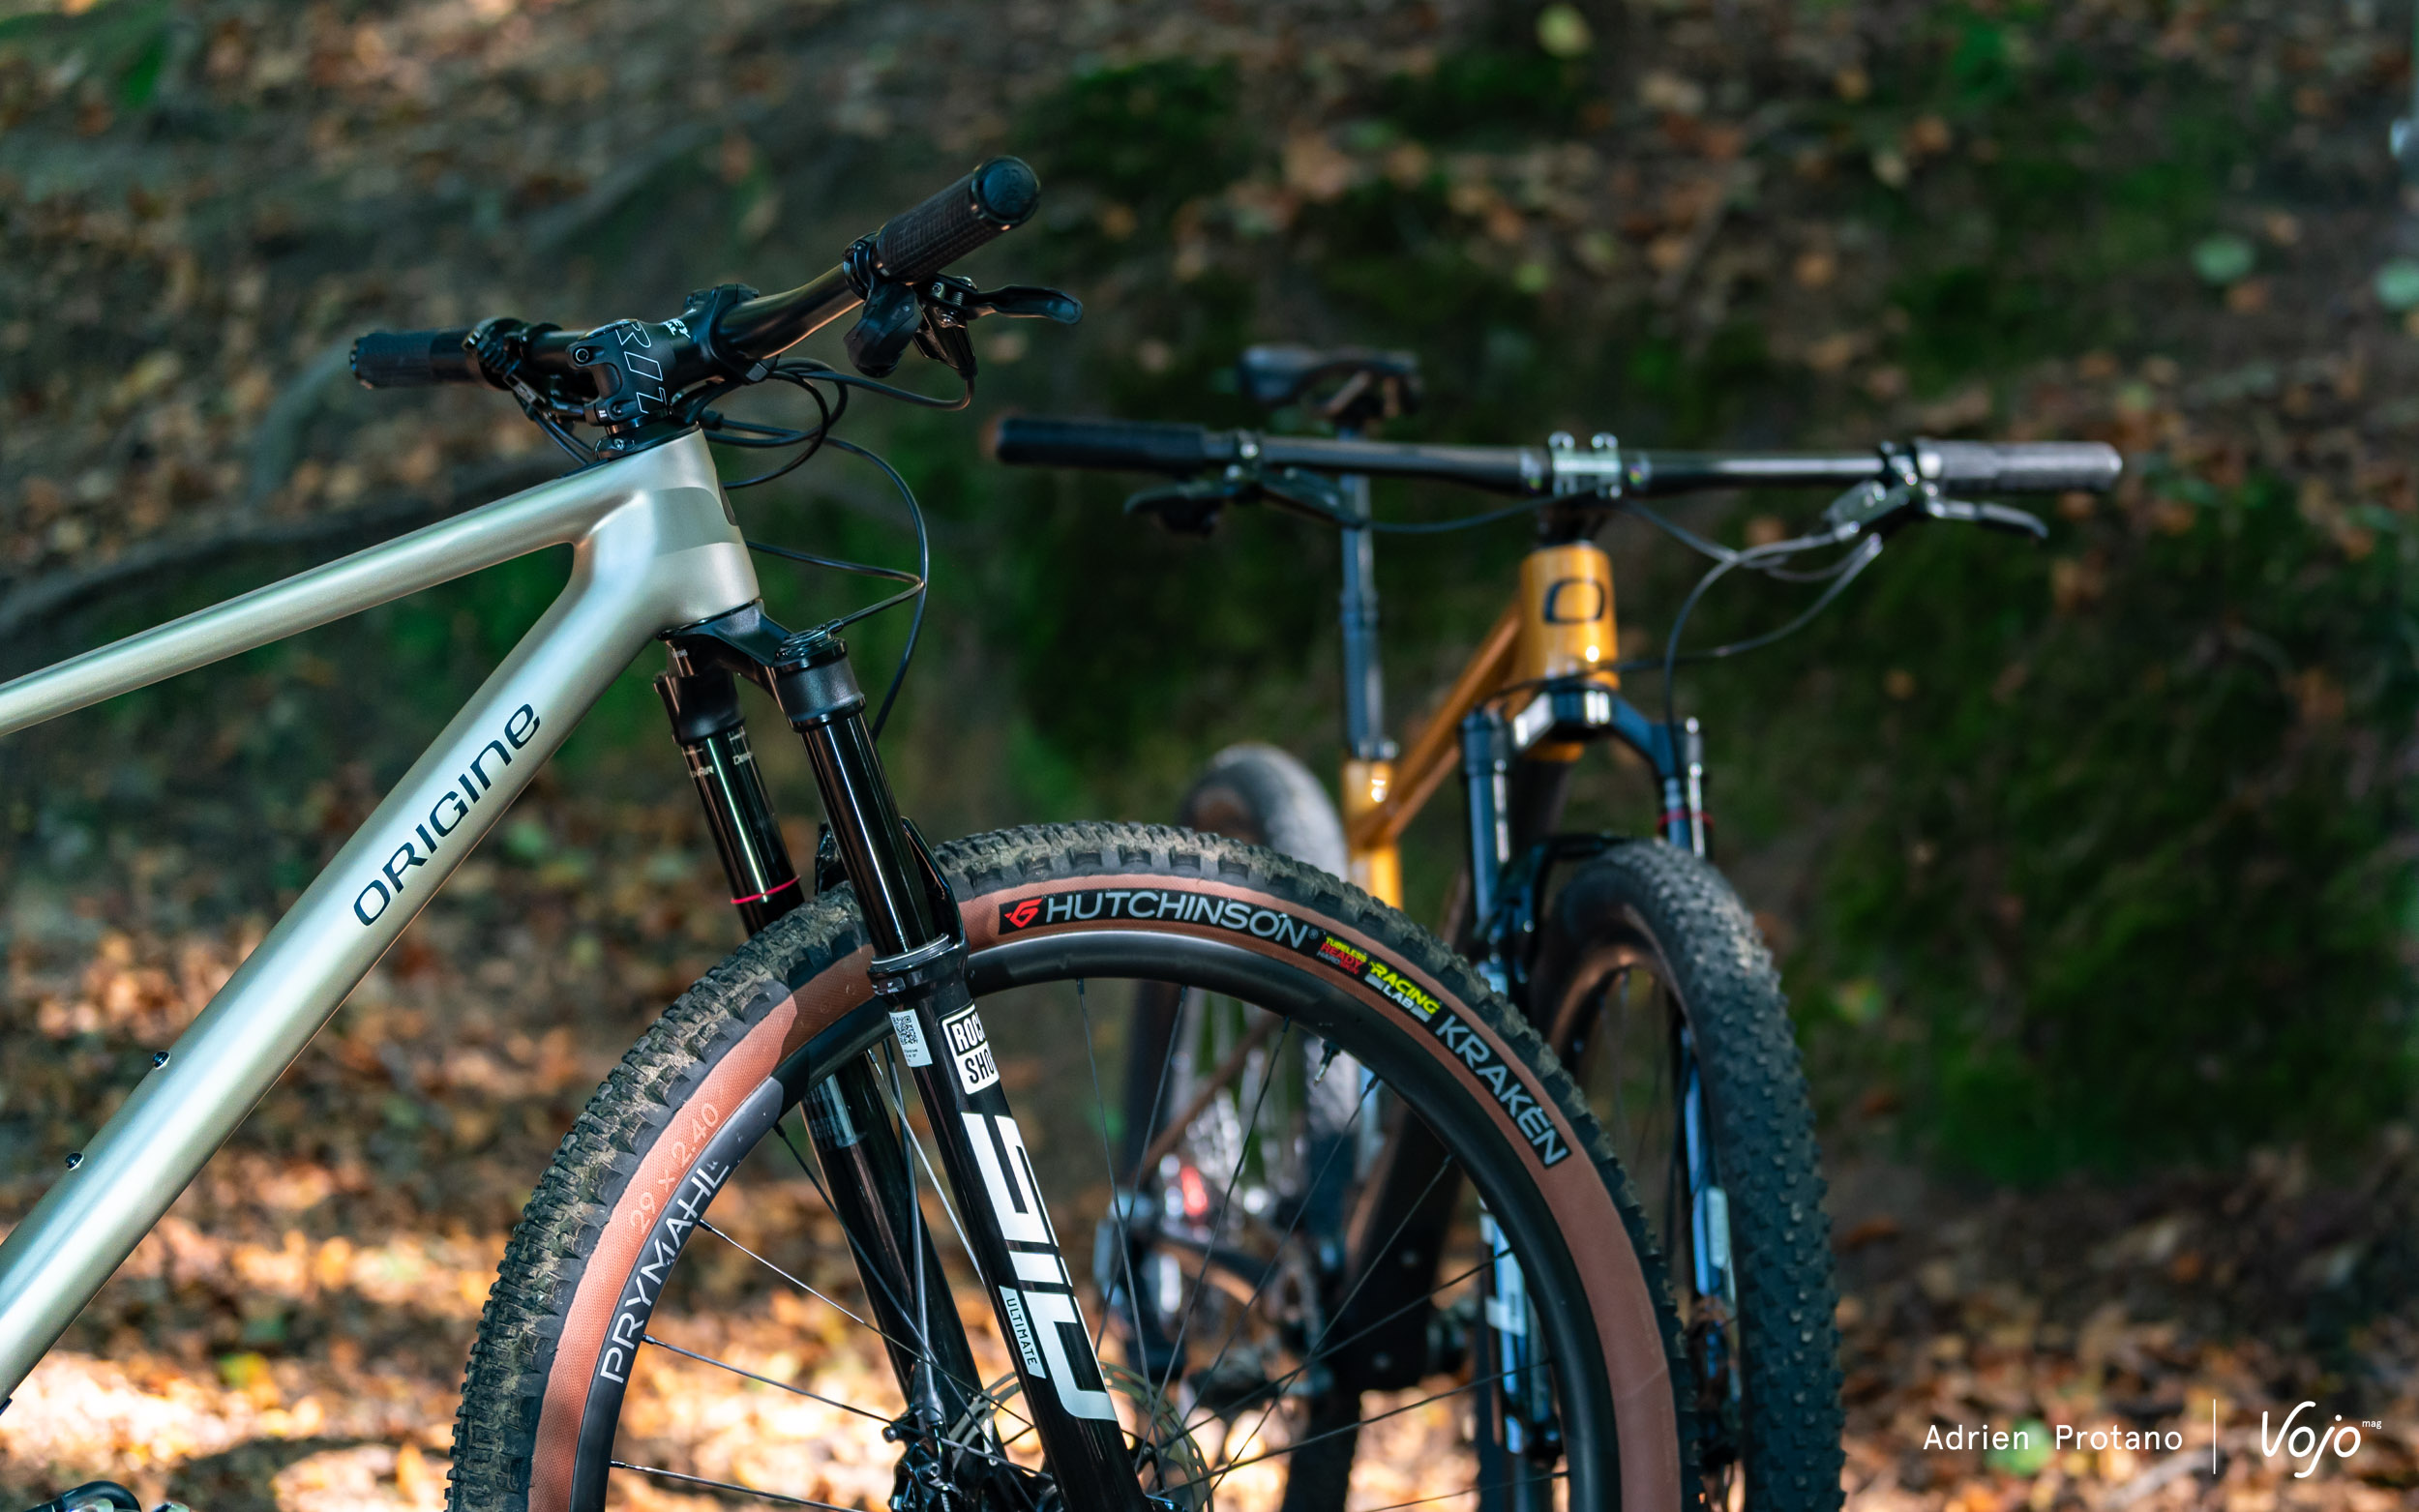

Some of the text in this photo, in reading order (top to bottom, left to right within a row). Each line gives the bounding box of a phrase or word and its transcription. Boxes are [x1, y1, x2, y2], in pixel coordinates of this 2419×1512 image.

[1320, 942, 1363, 968] READY
[1326, 936, 1367, 963] TUBELESS
[1369, 962, 1440, 1015] RACING
[1383, 985, 1415, 1009] LAB
[1435, 1015, 1568, 1165] KRAKEN
[630, 1192, 656, 1235] 29
[672, 1103, 719, 1167] 2.40
[600, 1165, 730, 1384] PRYMAHL
[1006, 1297, 1038, 1366] ULTIMATE
